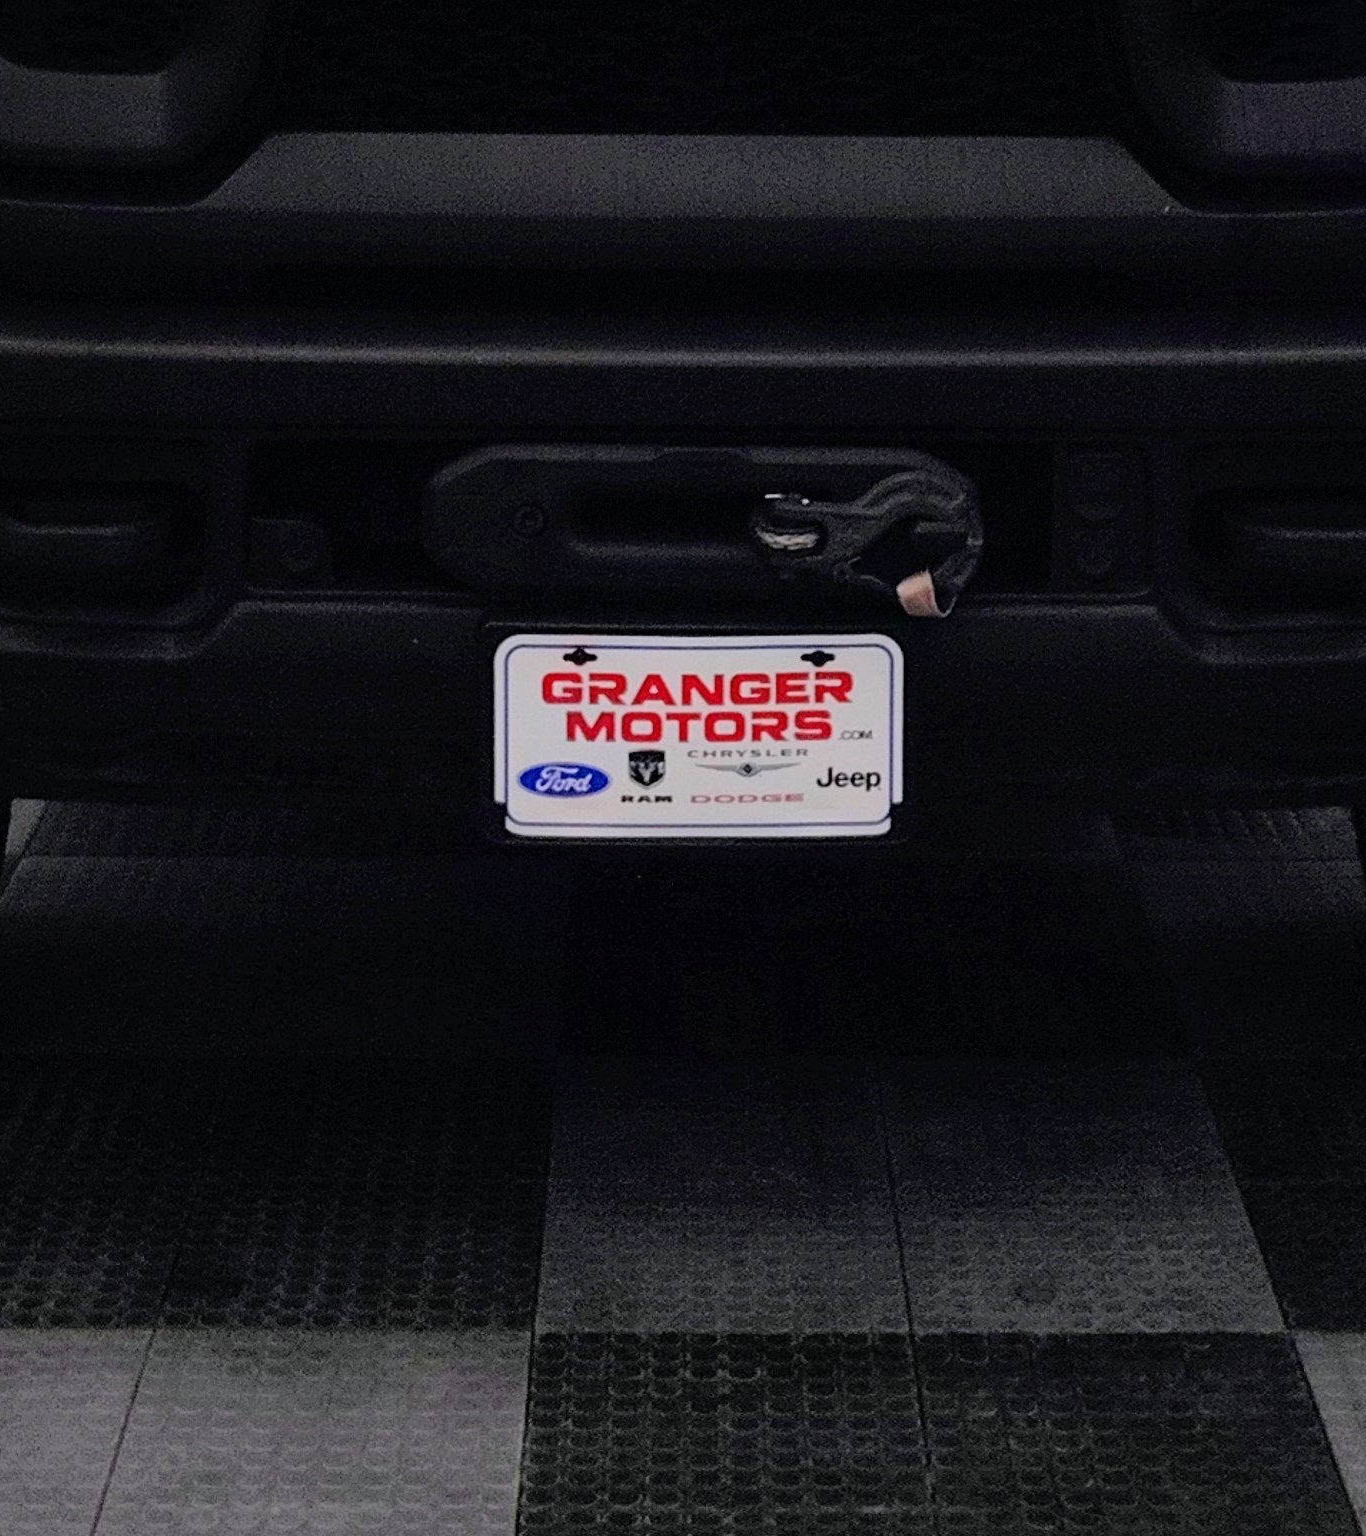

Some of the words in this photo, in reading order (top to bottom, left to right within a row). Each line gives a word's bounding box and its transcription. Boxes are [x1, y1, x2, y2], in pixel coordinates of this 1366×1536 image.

[541, 671, 854, 706] GRANGER
[565, 709, 833, 743] MOTORS
[687, 748, 809, 759] CHRYSLER
[535, 766, 593, 793] Ford
[817, 767, 881, 791] Jeep
[620, 794, 674, 804] RAM
[689, 793, 805, 804] DODGE
